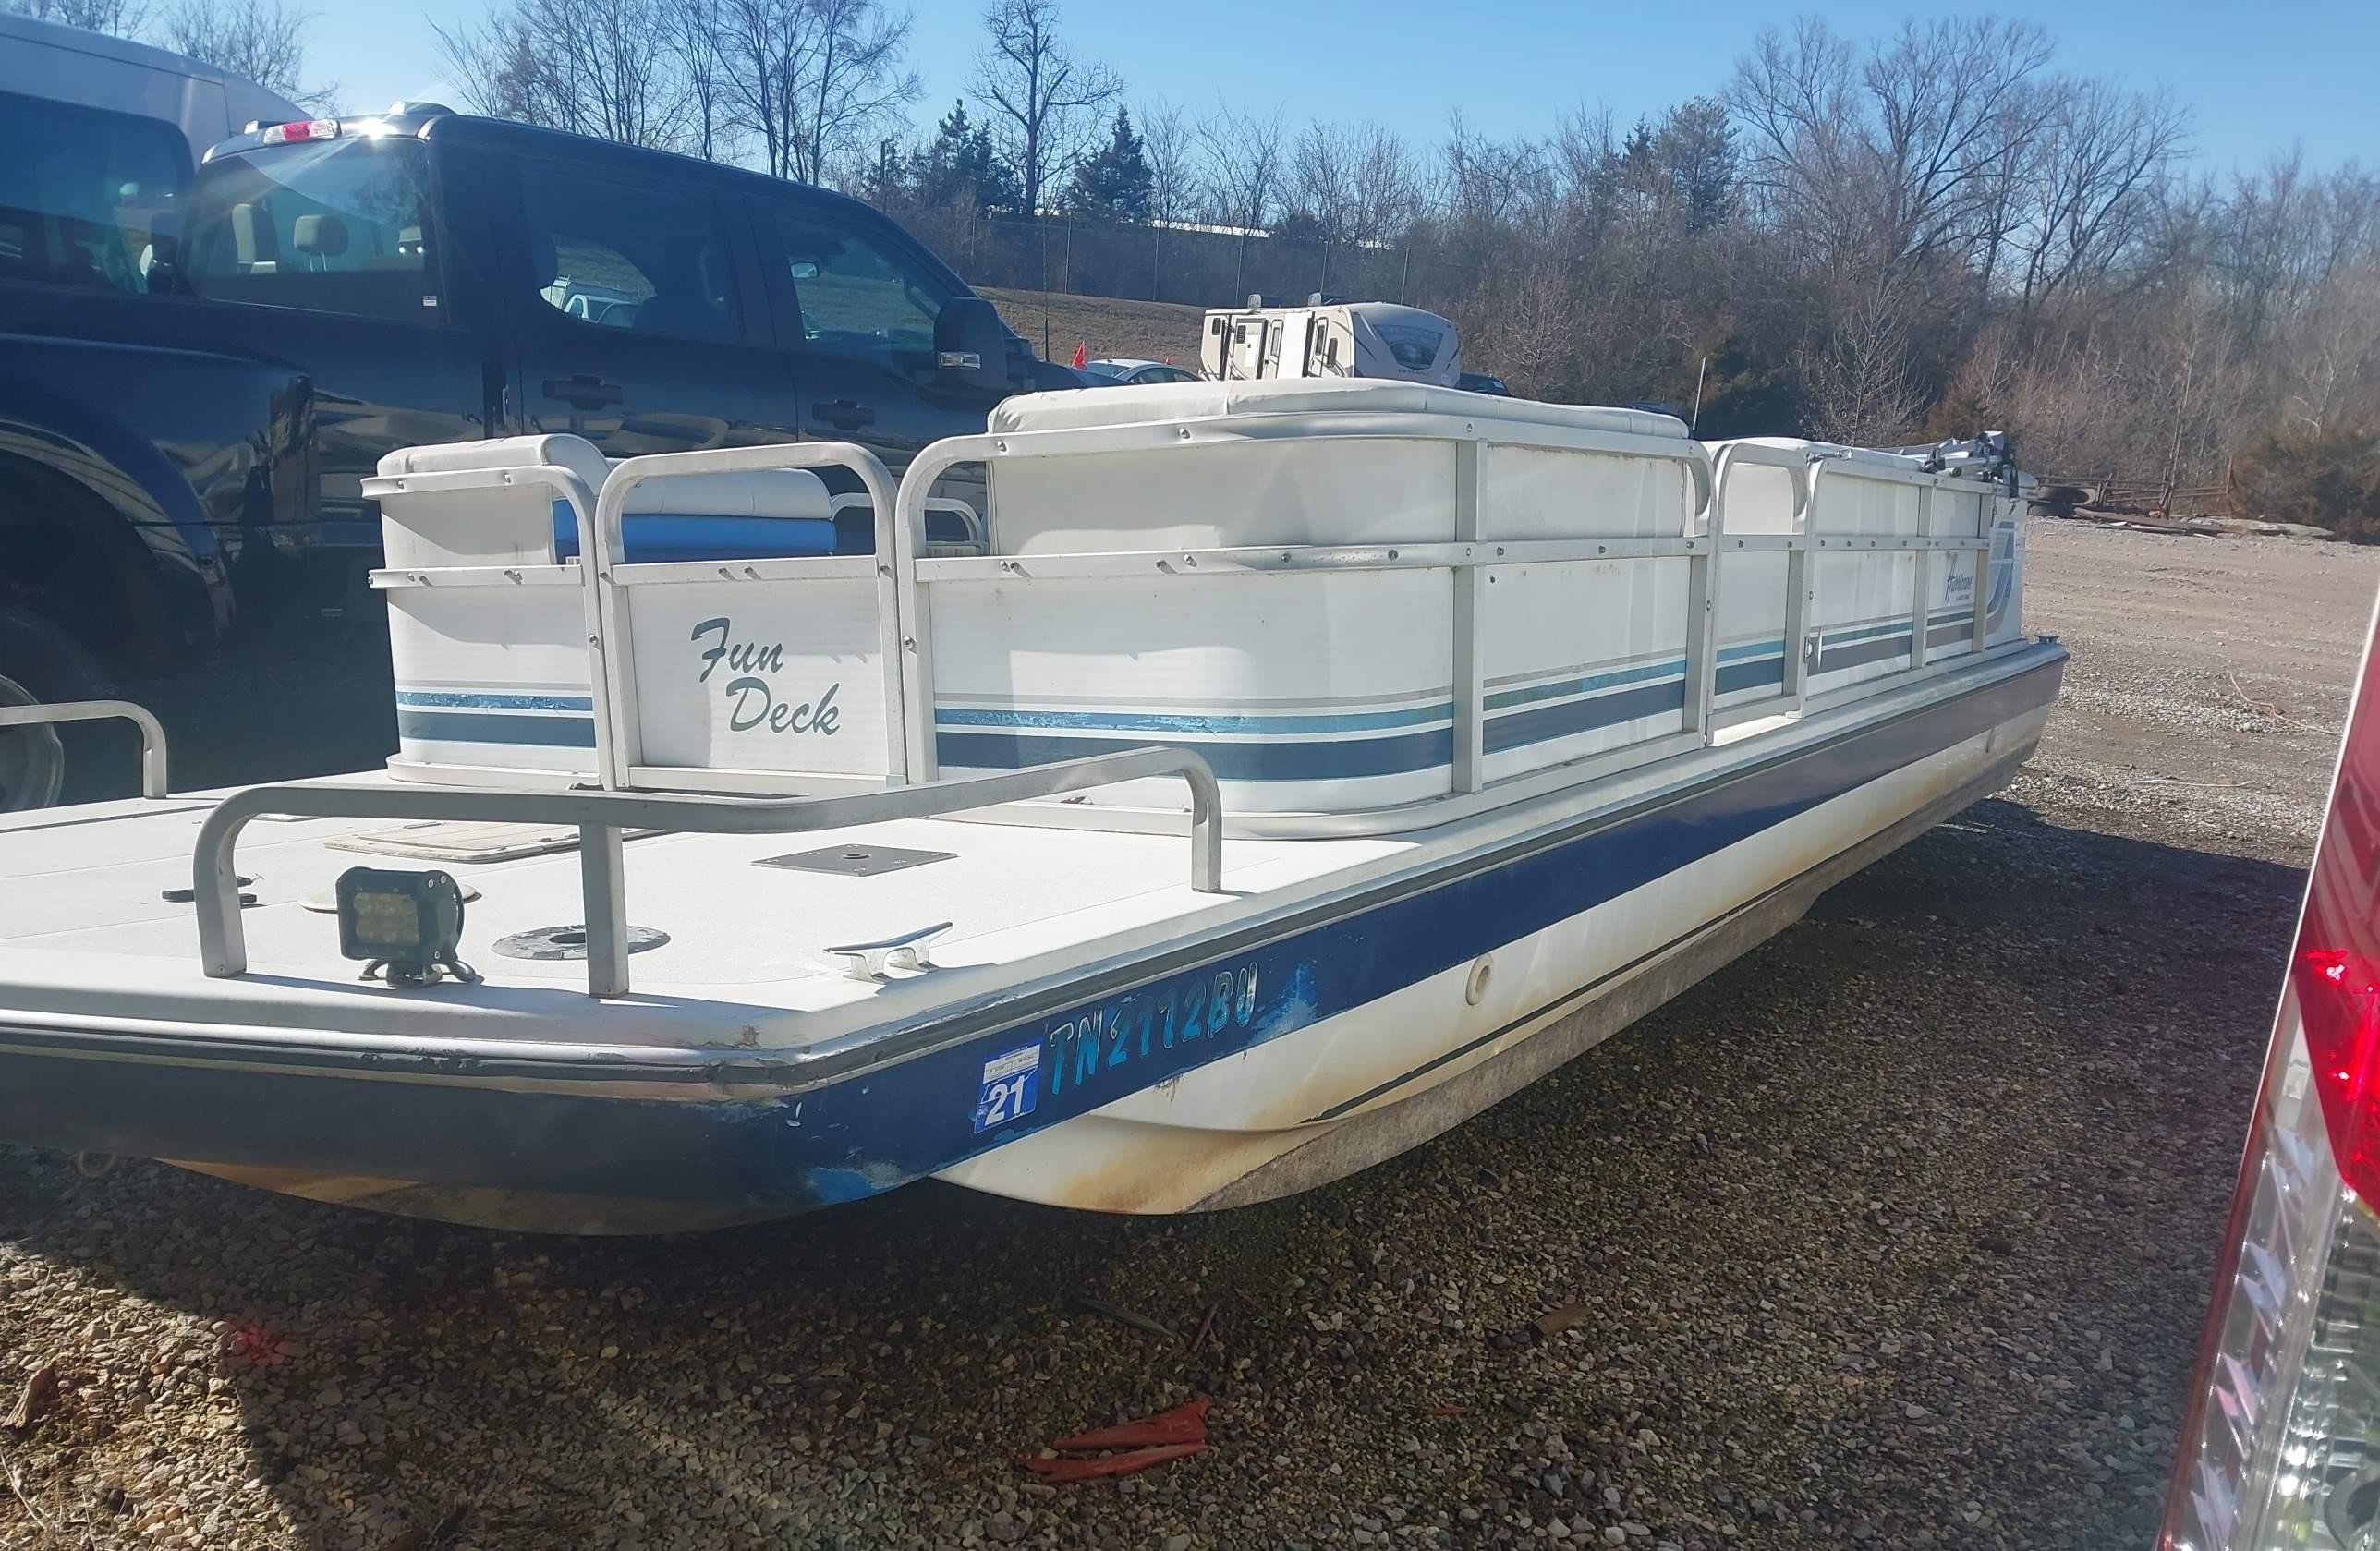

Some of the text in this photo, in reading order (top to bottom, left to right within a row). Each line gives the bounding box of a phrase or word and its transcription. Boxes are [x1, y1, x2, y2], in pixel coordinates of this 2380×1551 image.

[691, 617, 784, 683] Fun
[726, 677, 840, 736] Deck
[985, 1074, 1025, 1126] 21
